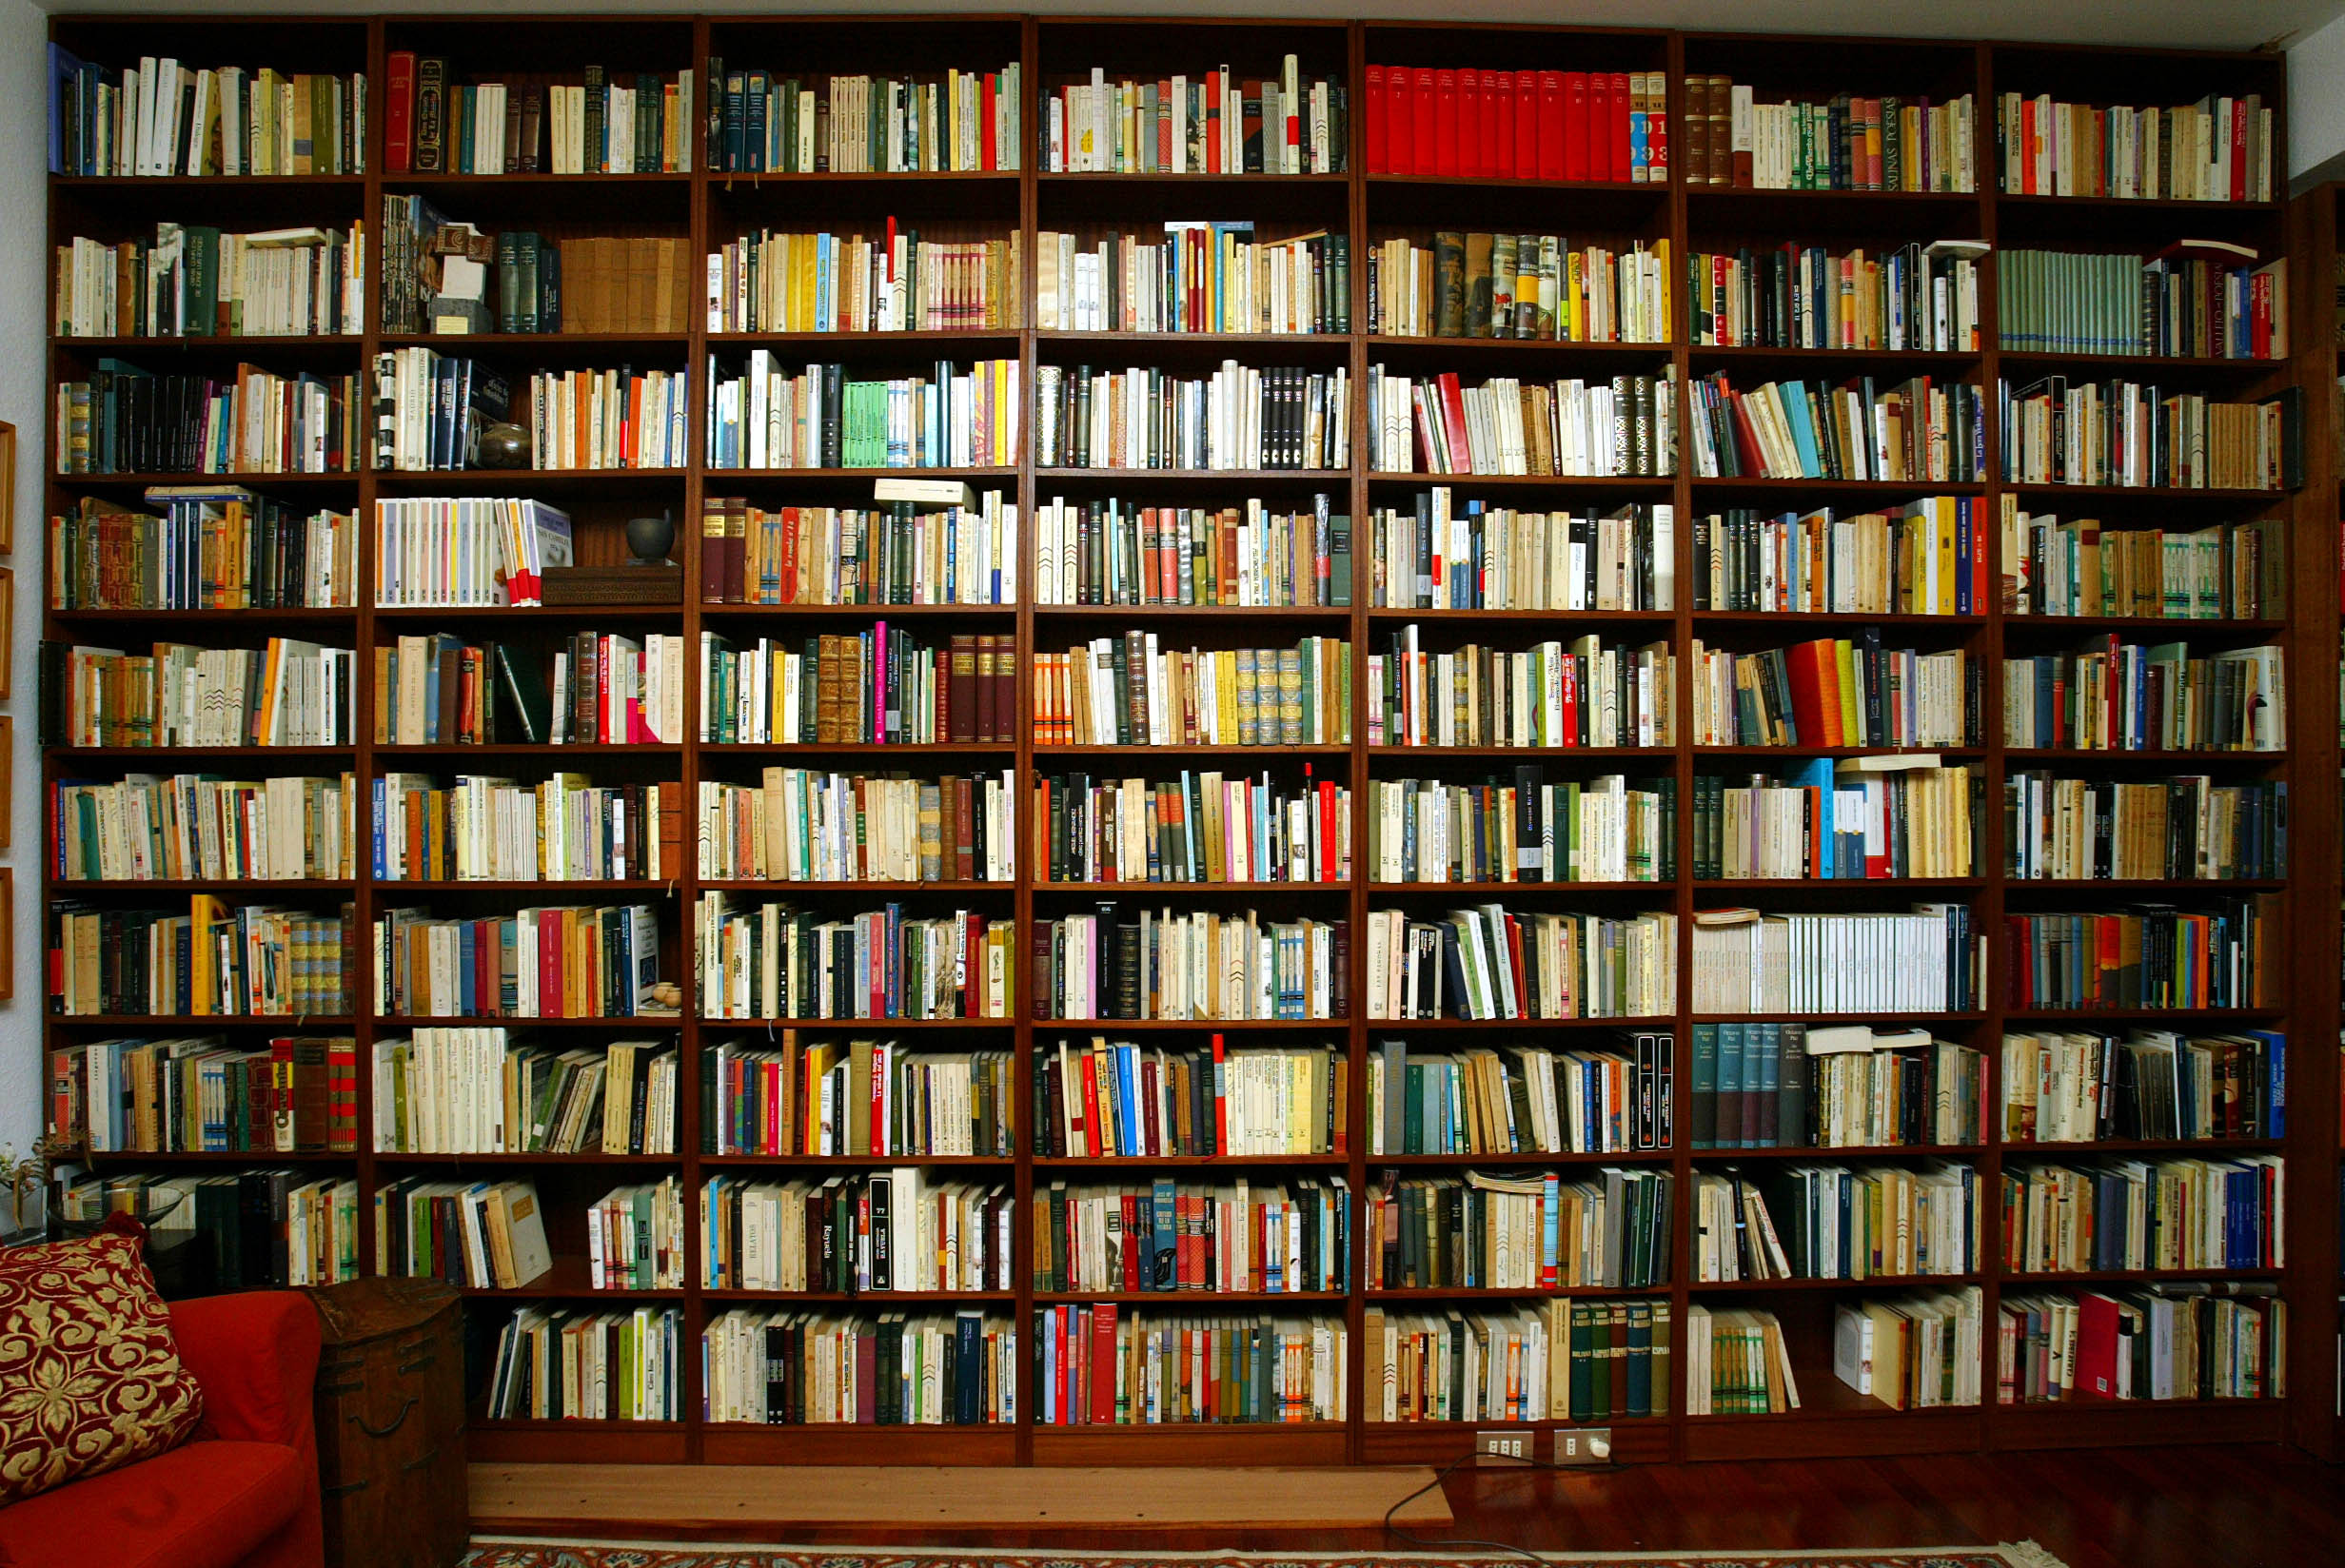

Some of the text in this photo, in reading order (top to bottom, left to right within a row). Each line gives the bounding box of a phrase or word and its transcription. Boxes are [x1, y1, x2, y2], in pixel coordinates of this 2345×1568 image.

[1885, 97, 1898, 190] SALINAS POESIAS
[823, 1225, 833, 1258] Rayuela
